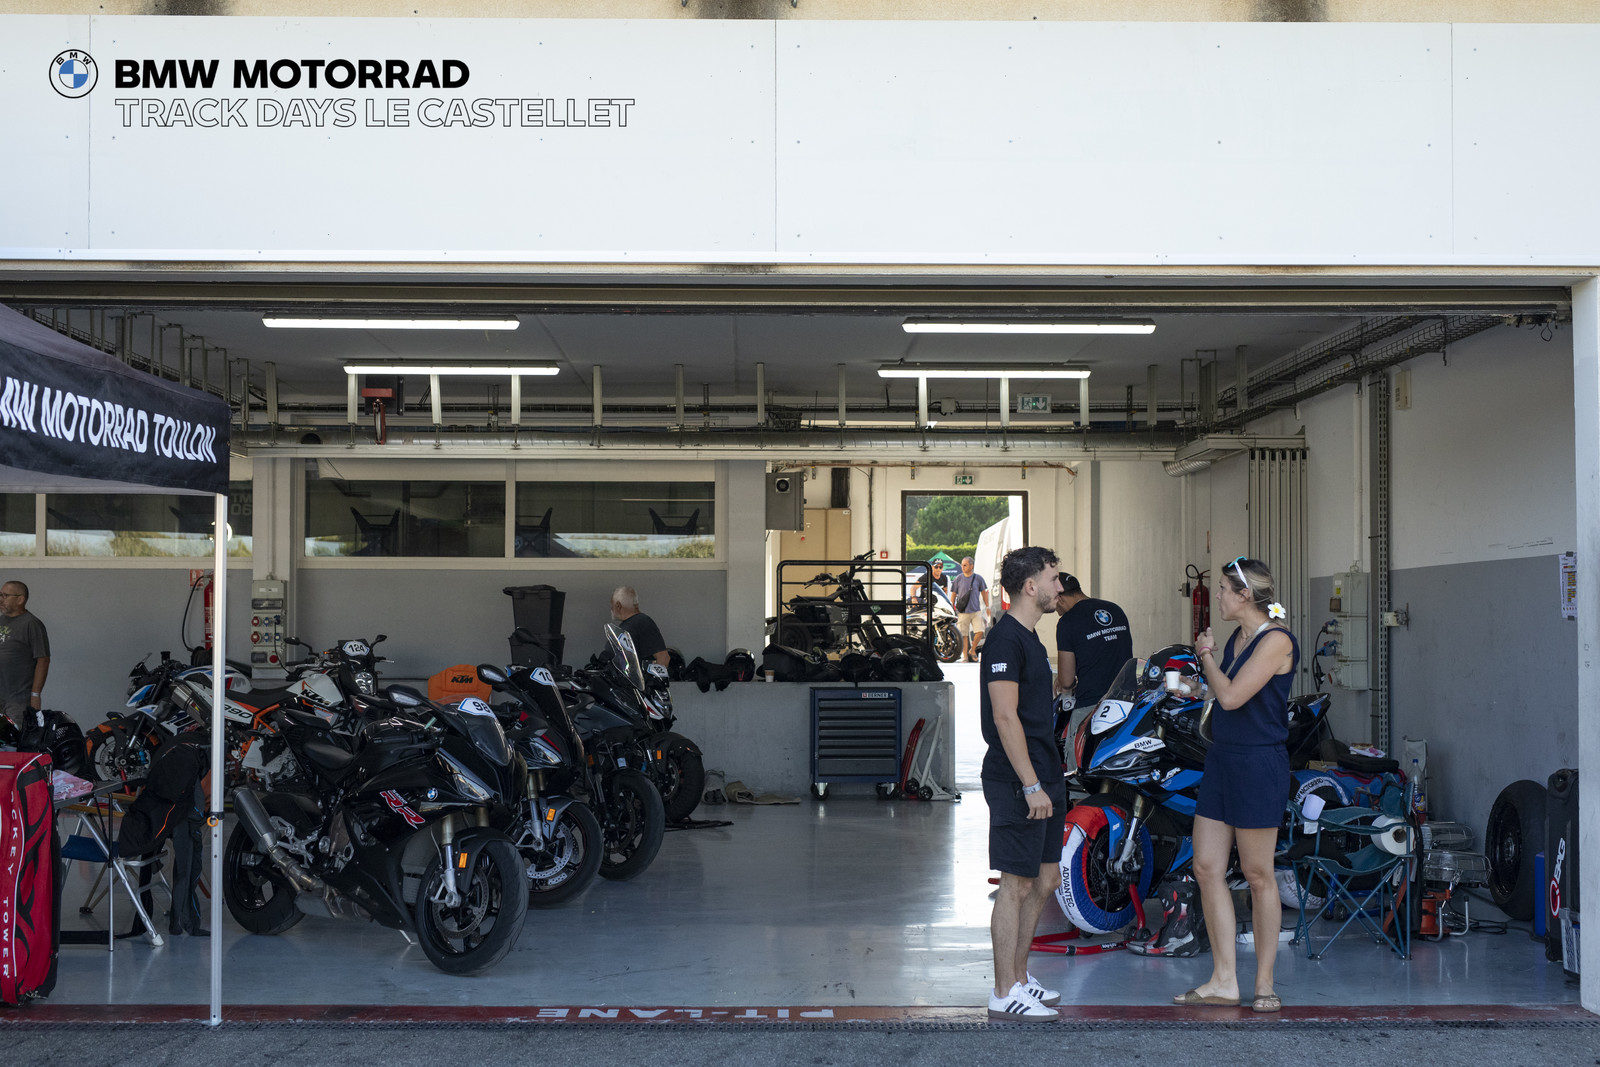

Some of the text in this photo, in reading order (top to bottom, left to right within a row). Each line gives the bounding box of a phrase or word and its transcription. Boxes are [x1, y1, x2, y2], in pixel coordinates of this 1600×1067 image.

[115, 59, 469, 89] BMW MOTORRAD
[115, 98, 635, 127] TRACK DAYS LE CASTELLET
[40, 386, 149, 454] MOTORRAD
[153, 412, 217, 464] TOULON
[1086, 625, 1127, 641] BMW MOTORRAD
[1103, 634, 1118, 642] TEAM
[348, 644, 365, 654] 124
[991, 662, 1008, 673] STAFF
[450, 674, 473, 684] KTM
[472, 701, 491, 713] 98
[1099, 705, 1111, 718] 2
[1134, 739, 1152, 749] BMW
[8, 790, 18, 876] CKEY
[1062, 866, 1075, 909] ADVANTEC
